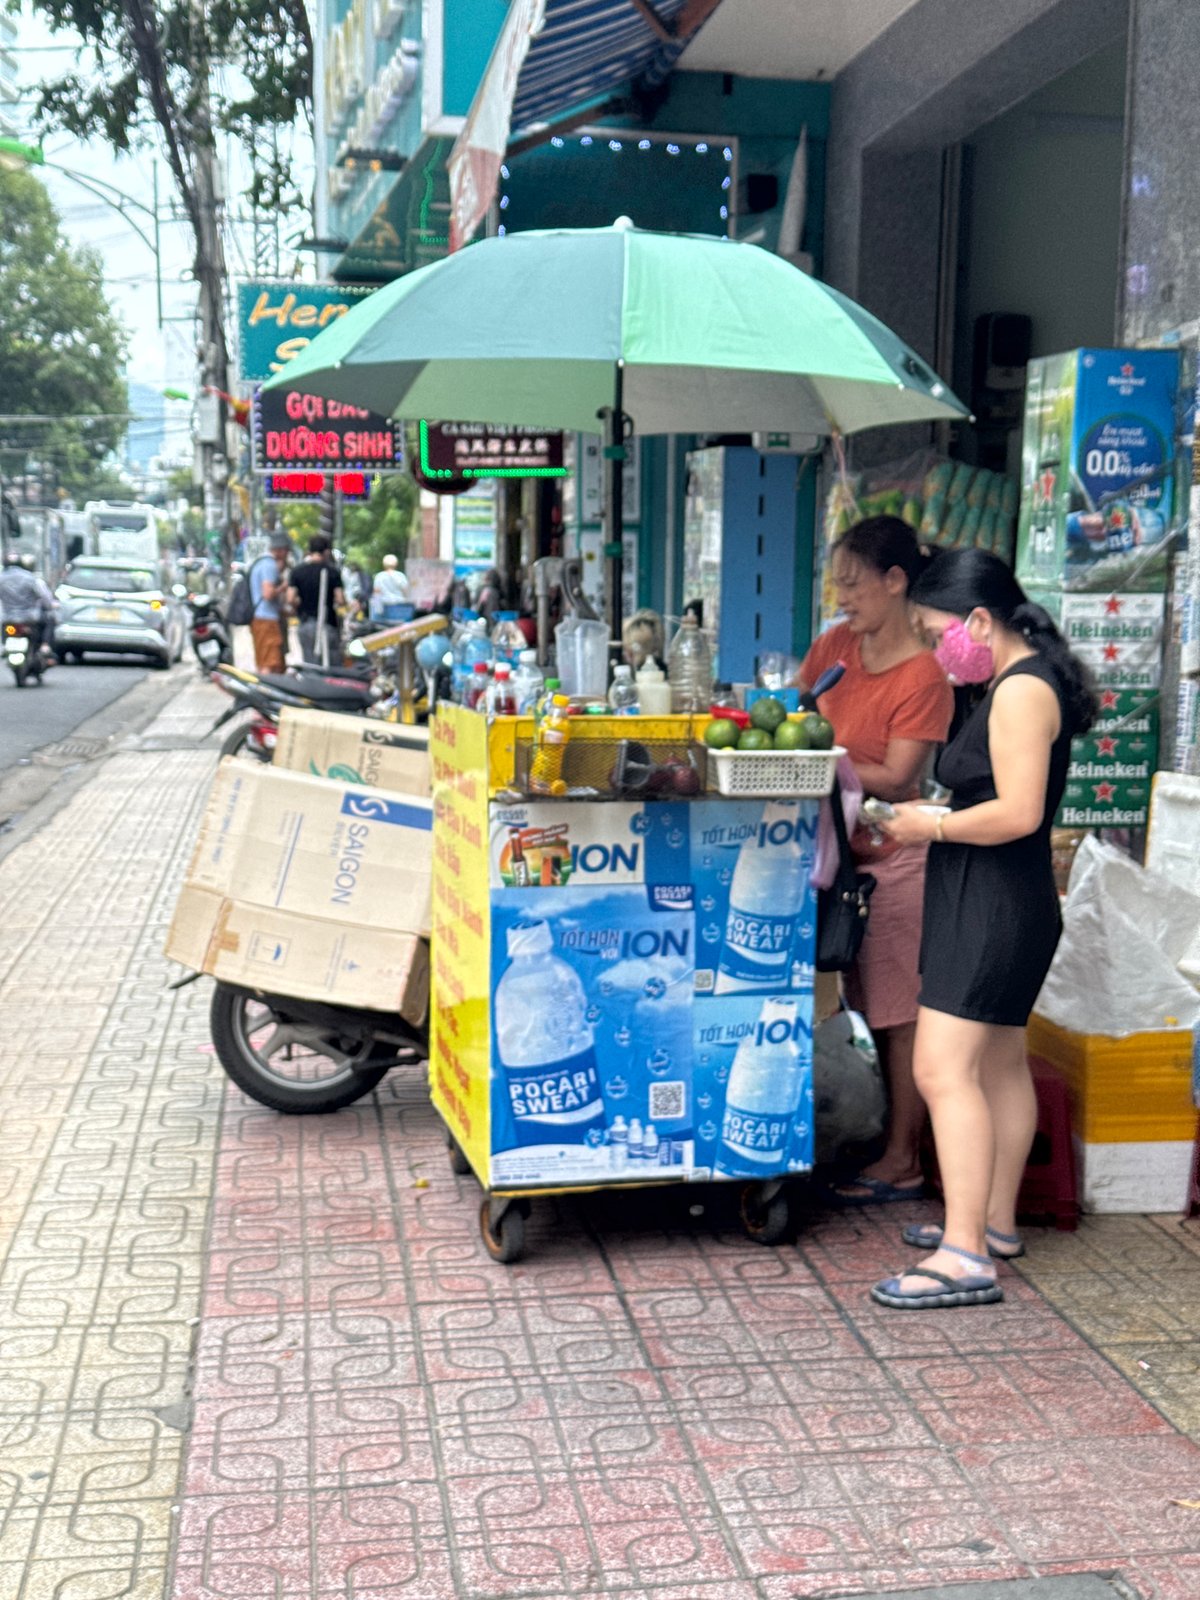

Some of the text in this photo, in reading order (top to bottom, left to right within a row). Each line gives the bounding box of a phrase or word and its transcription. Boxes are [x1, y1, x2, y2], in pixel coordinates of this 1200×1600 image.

[1070, 621, 1153, 638] Heineken
[1061, 807, 1146, 825] Heineken
[758, 815, 819, 848] ION
[331, 823, 370, 905] SAIGON
[571, 843, 639, 873] ION
[725, 930, 784, 950] SWEAT
[727, 917, 791, 937] POCARI
[620, 928, 690, 958] ION
[509, 1068, 597, 1100] POCARI
[512, 1085, 590, 1116] SWEAT
[723, 1112, 787, 1135] POCARI
[722, 1126, 780, 1148] SWEAT
